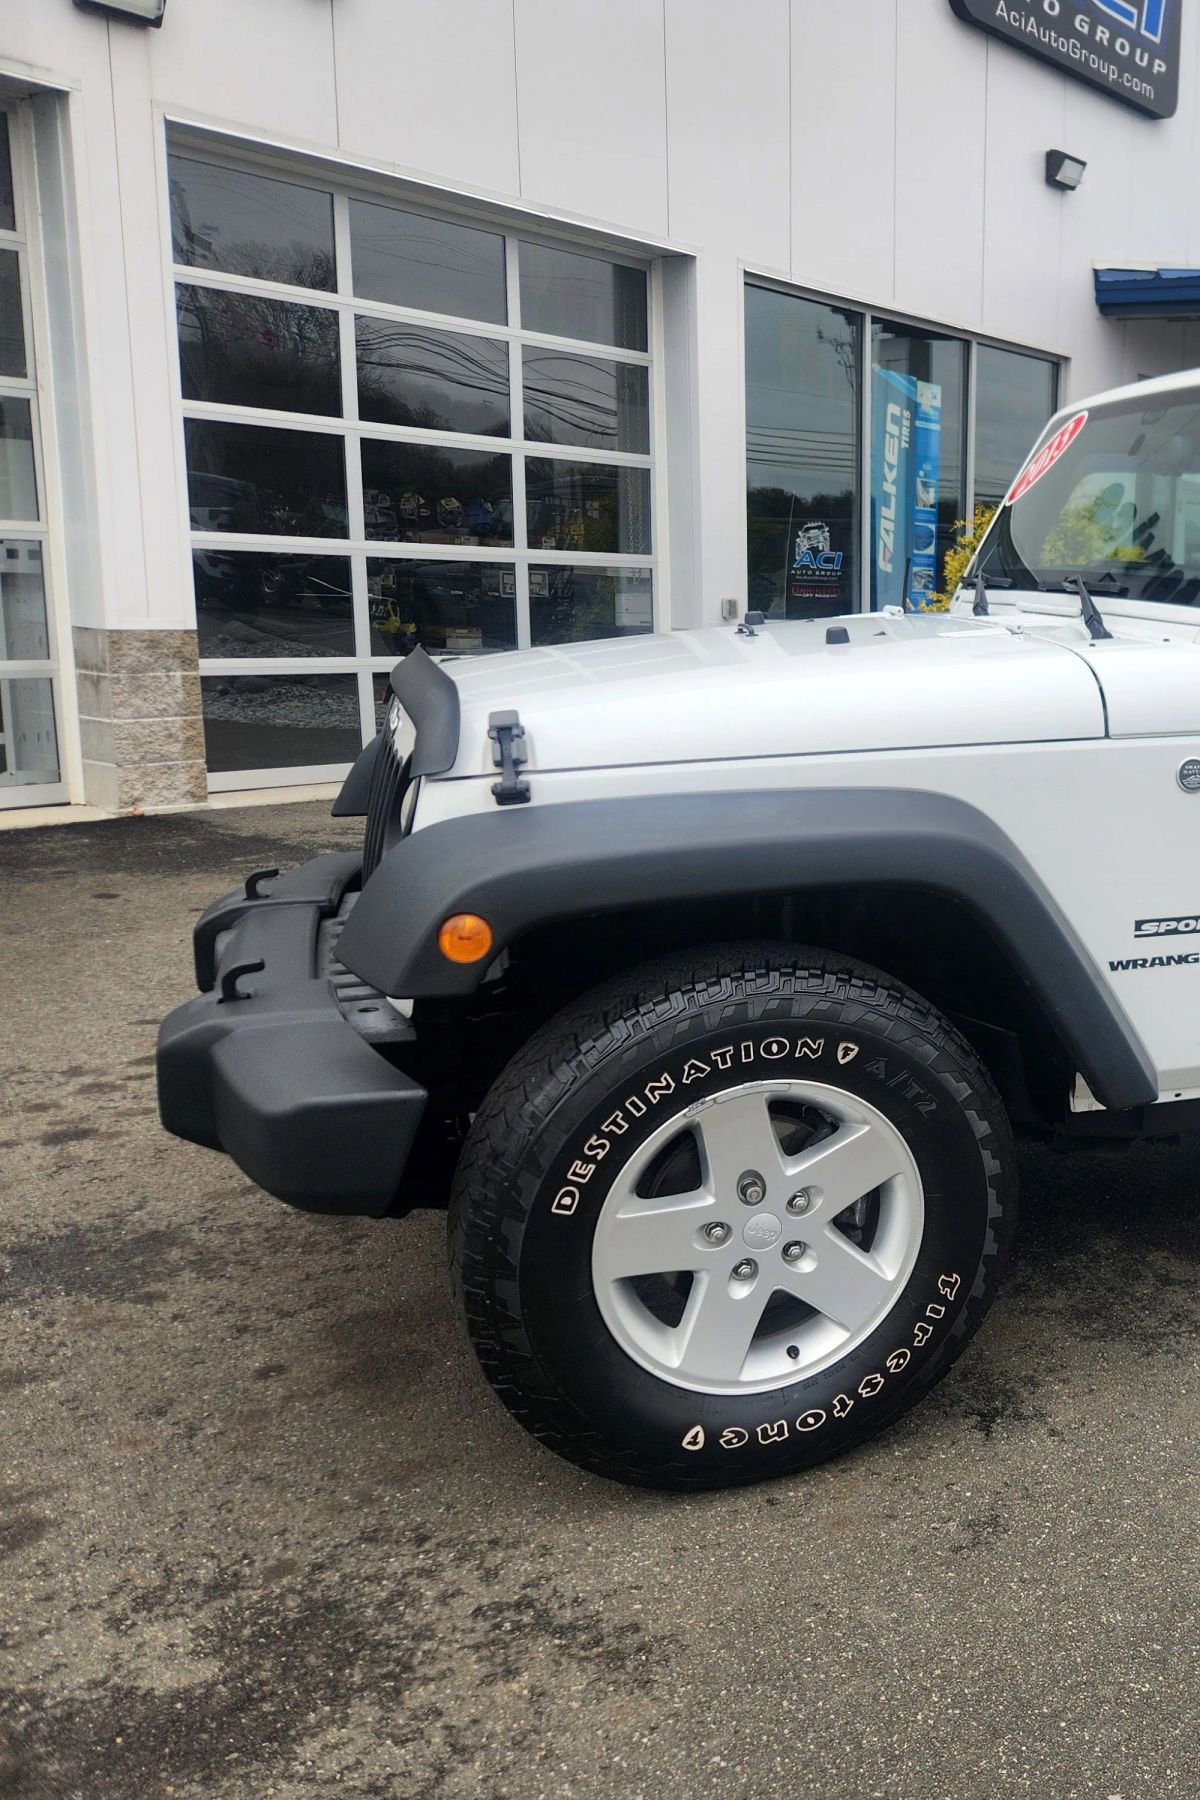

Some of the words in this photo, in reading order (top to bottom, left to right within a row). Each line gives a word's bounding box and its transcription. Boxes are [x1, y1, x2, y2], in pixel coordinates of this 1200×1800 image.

[994, 2, 1155, 100] AciAutoGroup.com
[1073, 13, 1168, 75] GROUP
[901, 409, 912, 449] TIRES
[793, 550, 843, 570] ACI
[551, 1037, 825, 1216] DESTINATION
[748, 1222, 778, 1241] Jeep
[719, 1273, 961, 1450] Firestone
